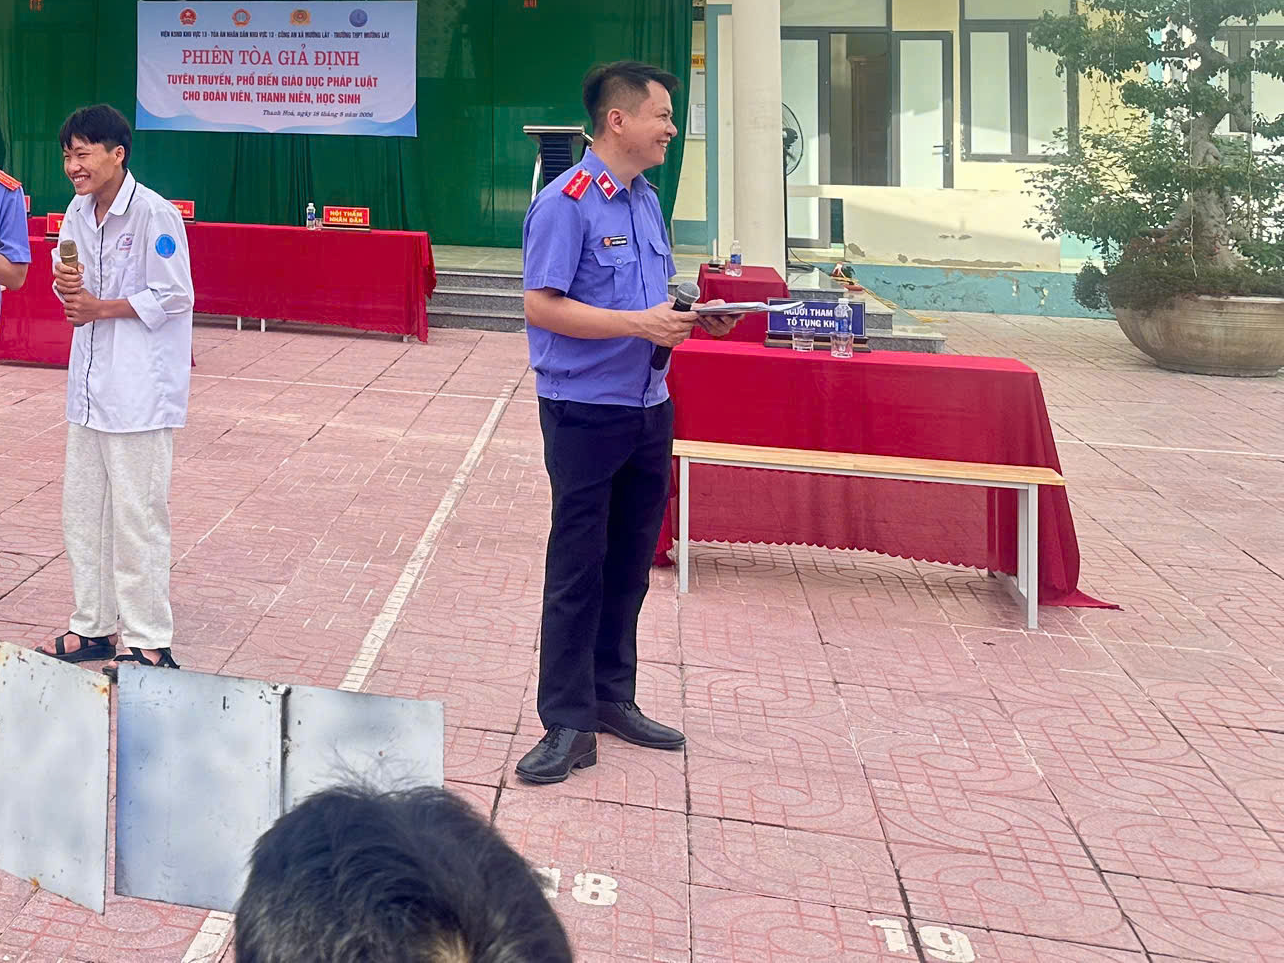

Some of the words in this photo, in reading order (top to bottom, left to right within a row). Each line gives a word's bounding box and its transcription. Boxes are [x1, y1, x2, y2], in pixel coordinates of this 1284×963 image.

[182, 45, 234, 65] PHIÊN
[239, 45, 273, 65] TÒA
[278, 43, 309, 66] GIẢ
[314, 50, 360, 70] ĐỊNH
[167, 73, 195, 85] TUYÊN
[257, 71, 279, 86] BIẾN
[281, 74, 303, 87] GIÁO
[306, 76, 324, 89] DỤC
[327, 74, 352, 87] PHÁP
[355, 74, 378, 90] LUẬT
[182, 90, 201, 101] CHO
[203, 90, 228, 102] ĐOÀN
[230, 90, 253, 103] VIÊN,
[256, 92, 286, 103] THANH
[288, 91, 314, 104] NIÊN,
[316, 93, 335, 106] HỌC
[338, 93, 361, 104] SINH
[810, 308, 833, 317] THAM
[799, 318, 821, 329] TỤNG
[867, 918, 976, 963] 19
